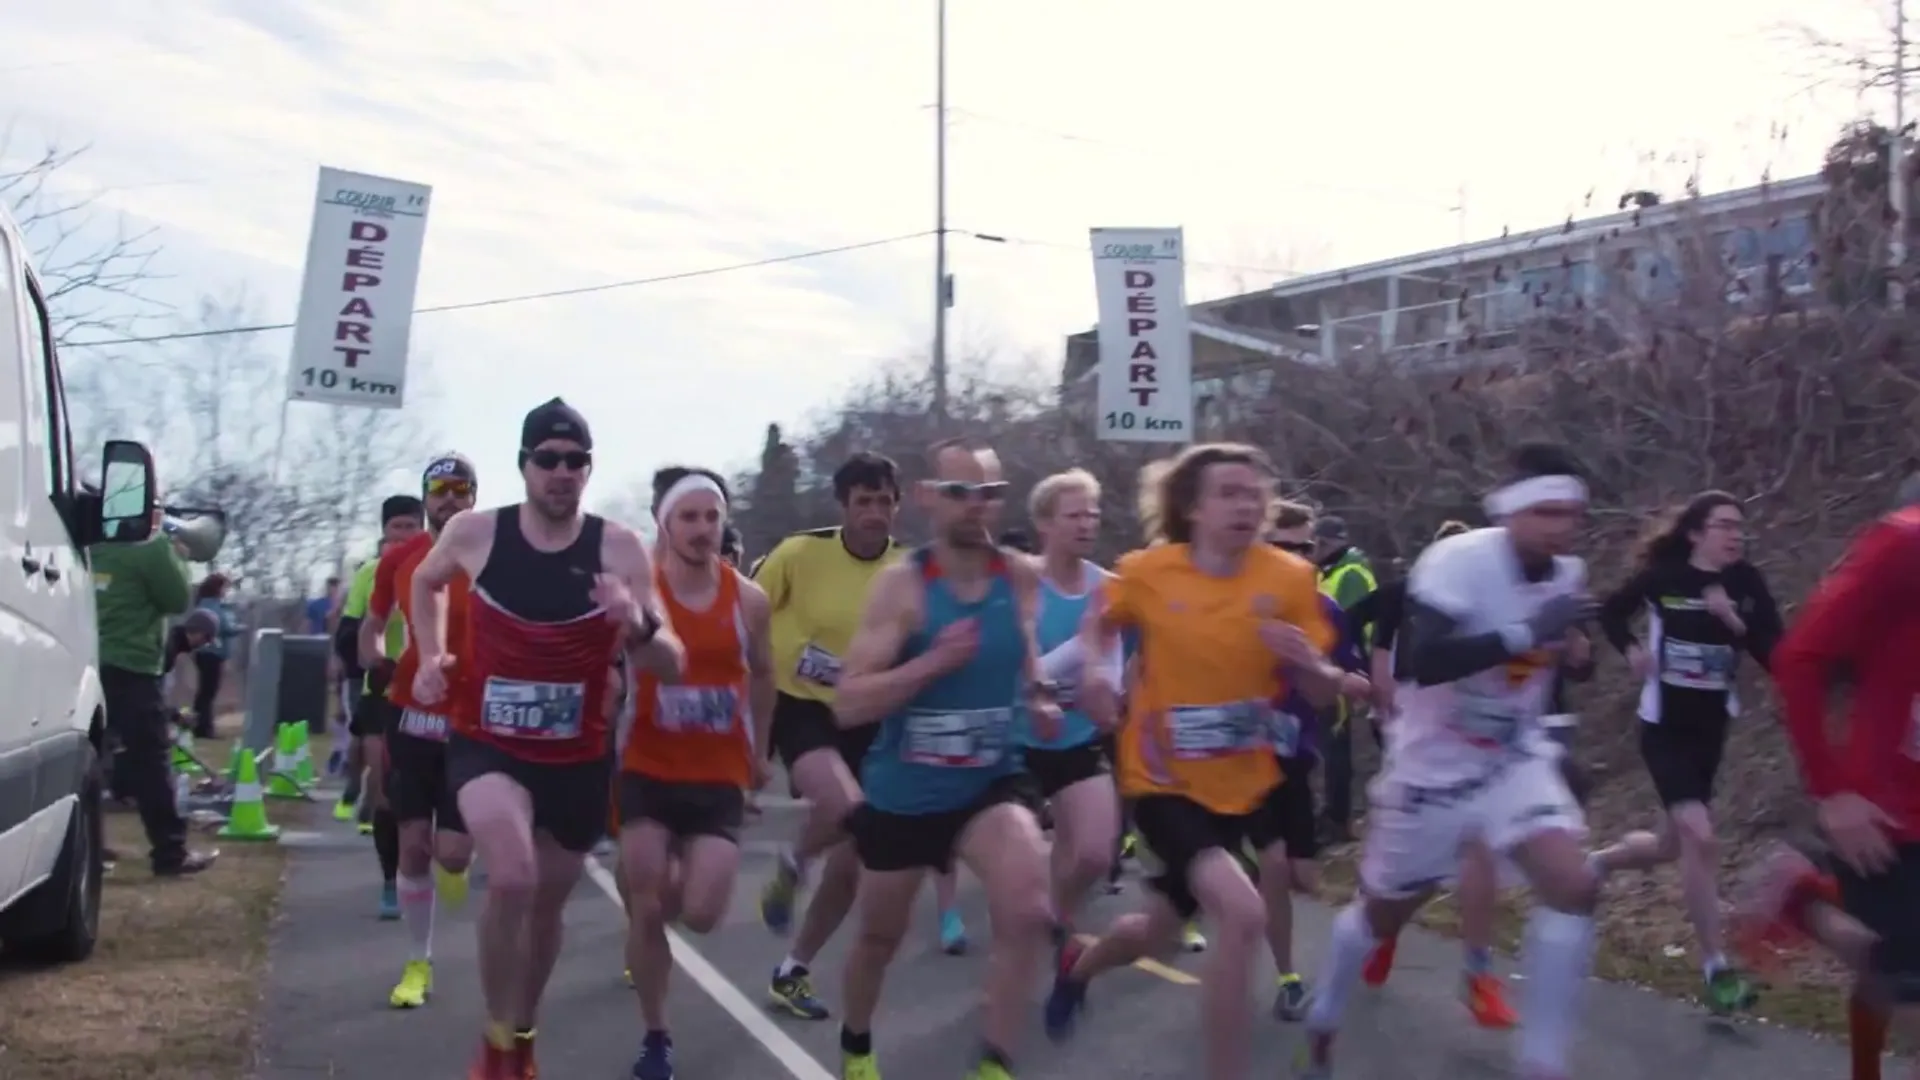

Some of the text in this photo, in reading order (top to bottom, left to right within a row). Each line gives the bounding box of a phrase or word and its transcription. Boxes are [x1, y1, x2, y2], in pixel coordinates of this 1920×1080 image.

[333, 221, 388, 368] DÉPART
[1124, 271, 1159, 406] DÉPART
[301, 366, 397, 395] 10 km
[1105, 411, 1183, 431] 10 km
[488, 703, 544, 728] 5310
